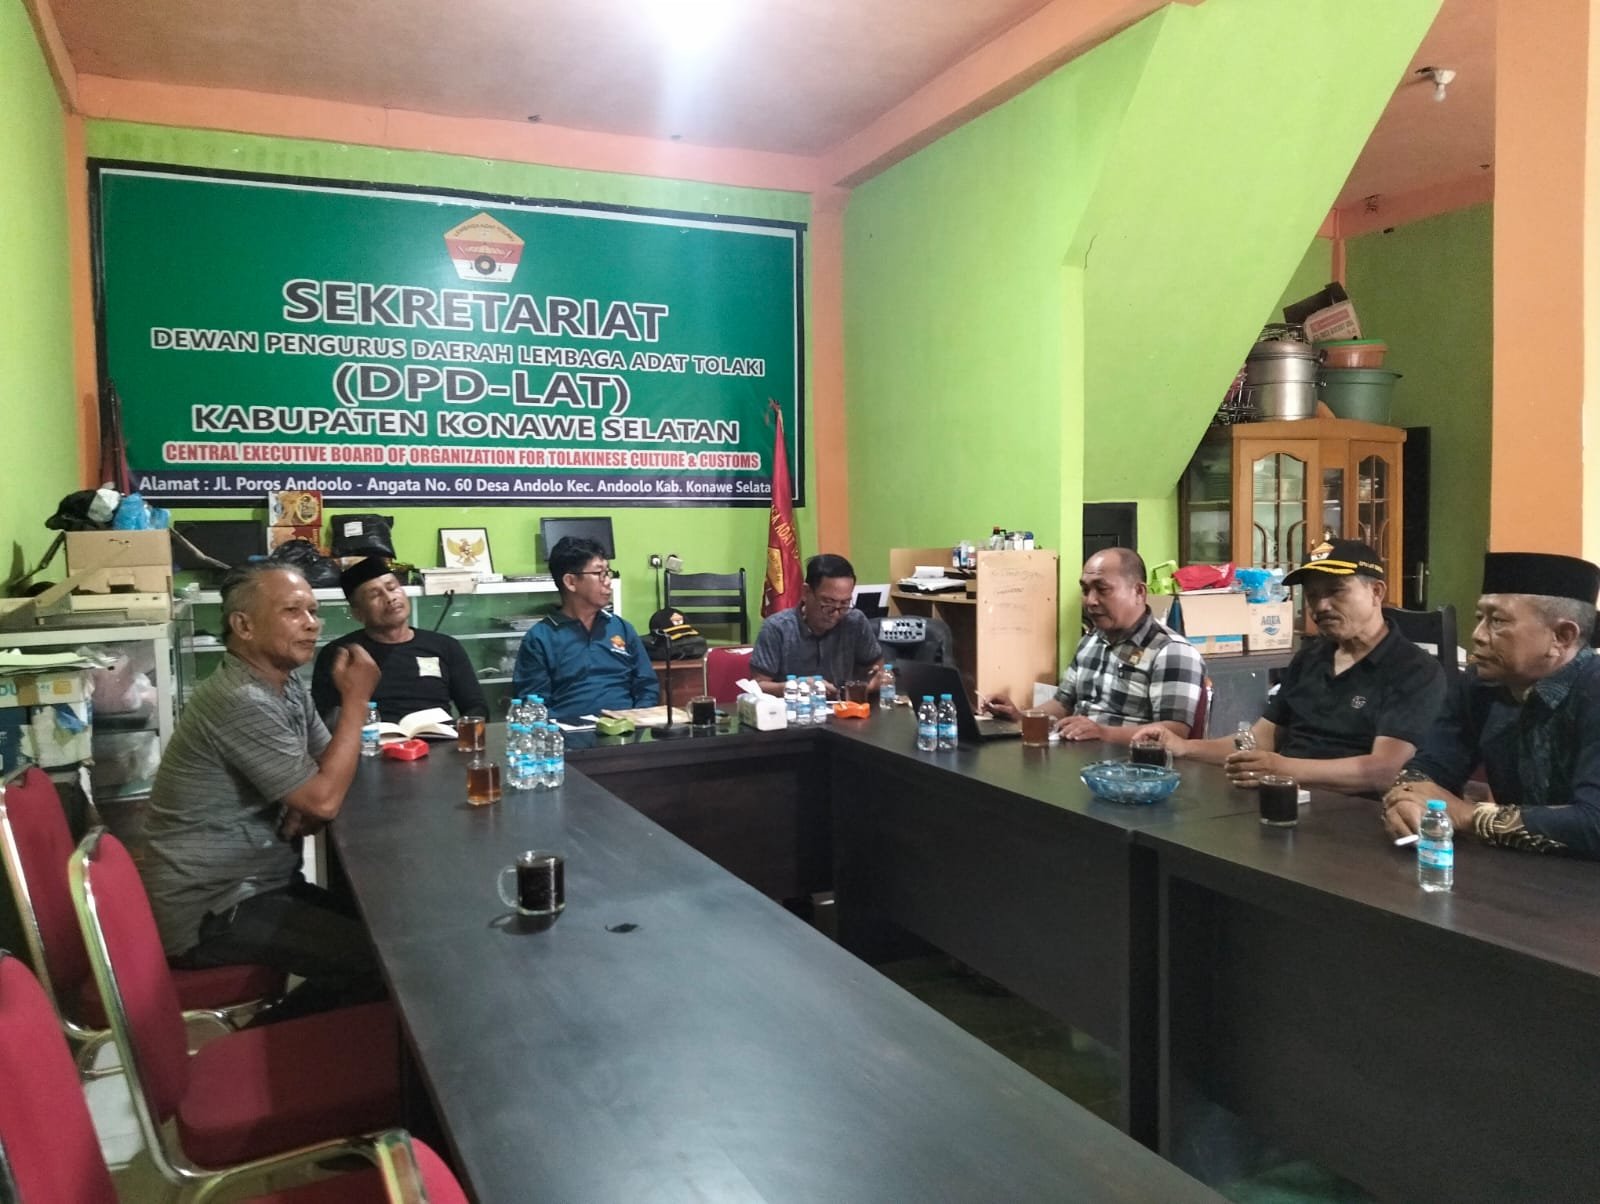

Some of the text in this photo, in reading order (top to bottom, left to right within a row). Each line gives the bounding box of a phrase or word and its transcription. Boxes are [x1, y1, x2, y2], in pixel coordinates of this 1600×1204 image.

[283, 279, 668, 342] SEKRETARIAT
[152, 328, 765, 376] DEWAN PENGURUS DAERAH LEMBAGA ADAT TOLAKI
[332, 362, 631, 414] (DPD-LAT)
[192, 404, 740, 444] KABUPATEN KONAWE SELATAN
[165, 443, 760, 470] CENTRAL EXECUTIVE BOARD OF ORGANIZATION FOR TOLAKINESE CULTURE & CUSTOMS
[139, 476, 200, 491] Alamat
[236, 477, 280, 491] Poros
[285, 477, 352, 491] Andoolo
[367, 478, 422, 495] Angata
[425, 479, 451, 492] No.
[454, 479, 472, 492] 60
[476, 479, 513, 492] Desa
[515, 479, 564, 492] Andolo
[567, 479, 594, 492] Kec.
[598, 480, 652, 493] Andoolo
[655, 480, 682, 493] Kab.
[686, 482, 733, 494] Konawe
[735, 481, 771, 494] Selata
[1261, 615, 1281, 626] AQUA
